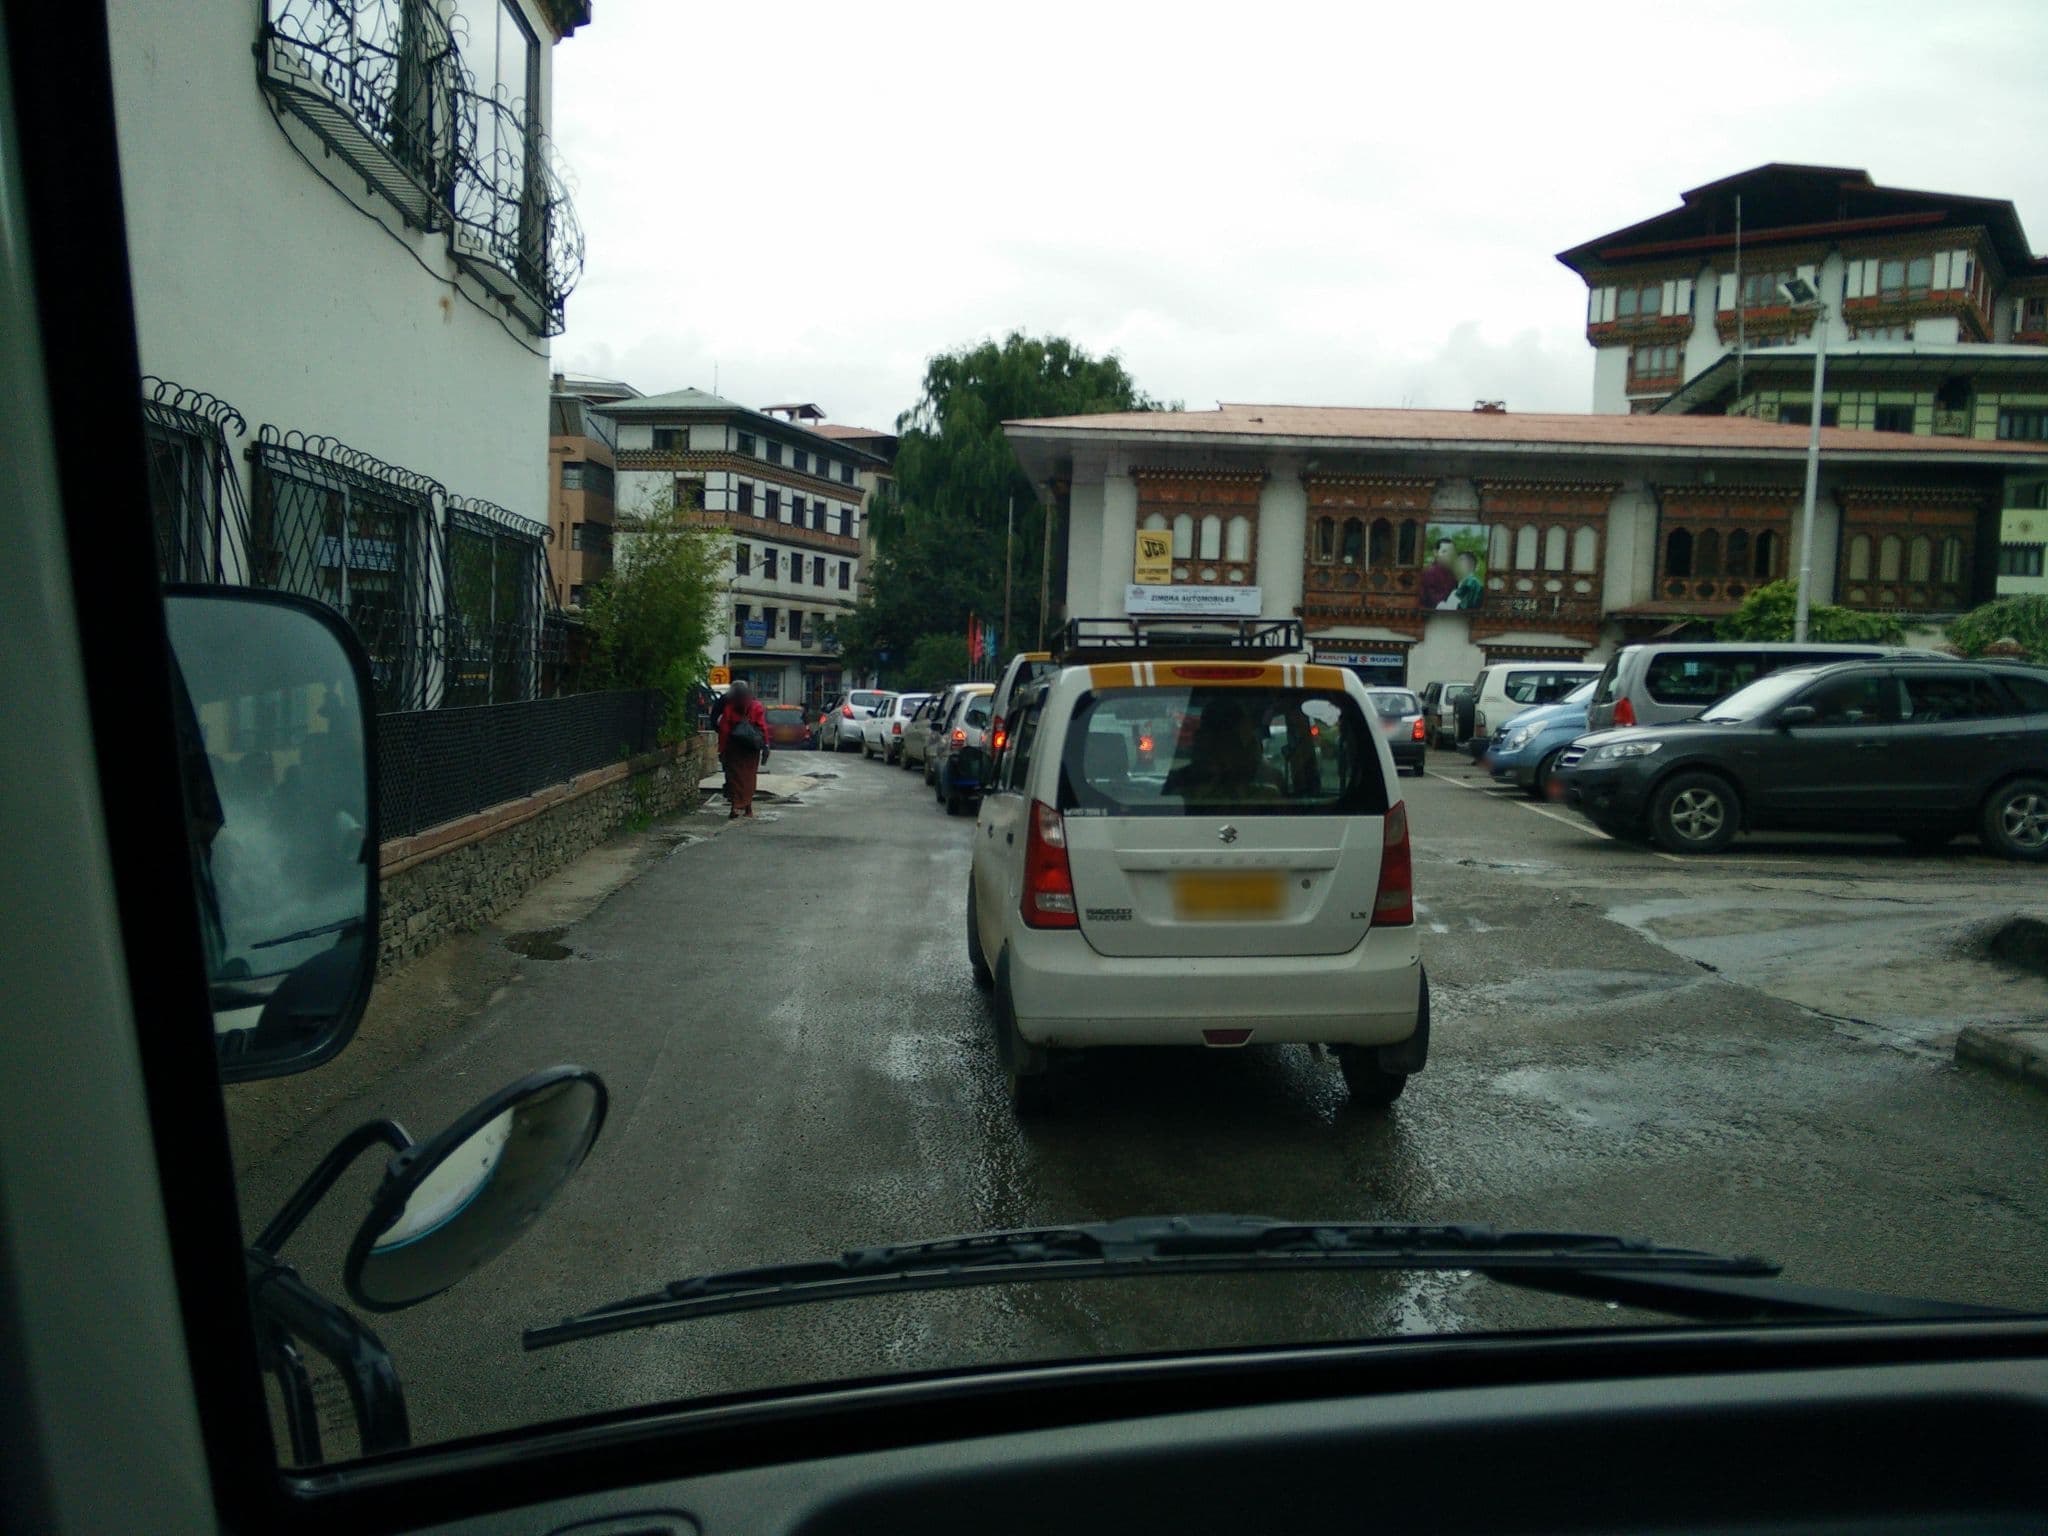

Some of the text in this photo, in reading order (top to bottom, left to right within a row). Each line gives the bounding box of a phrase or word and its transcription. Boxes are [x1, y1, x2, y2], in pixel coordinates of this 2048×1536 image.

[1144, 540, 1166, 558] JCB
[1182, 595, 1235, 603] AUTOMOBILES
[1370, 656, 1402, 664] SUZUKI
